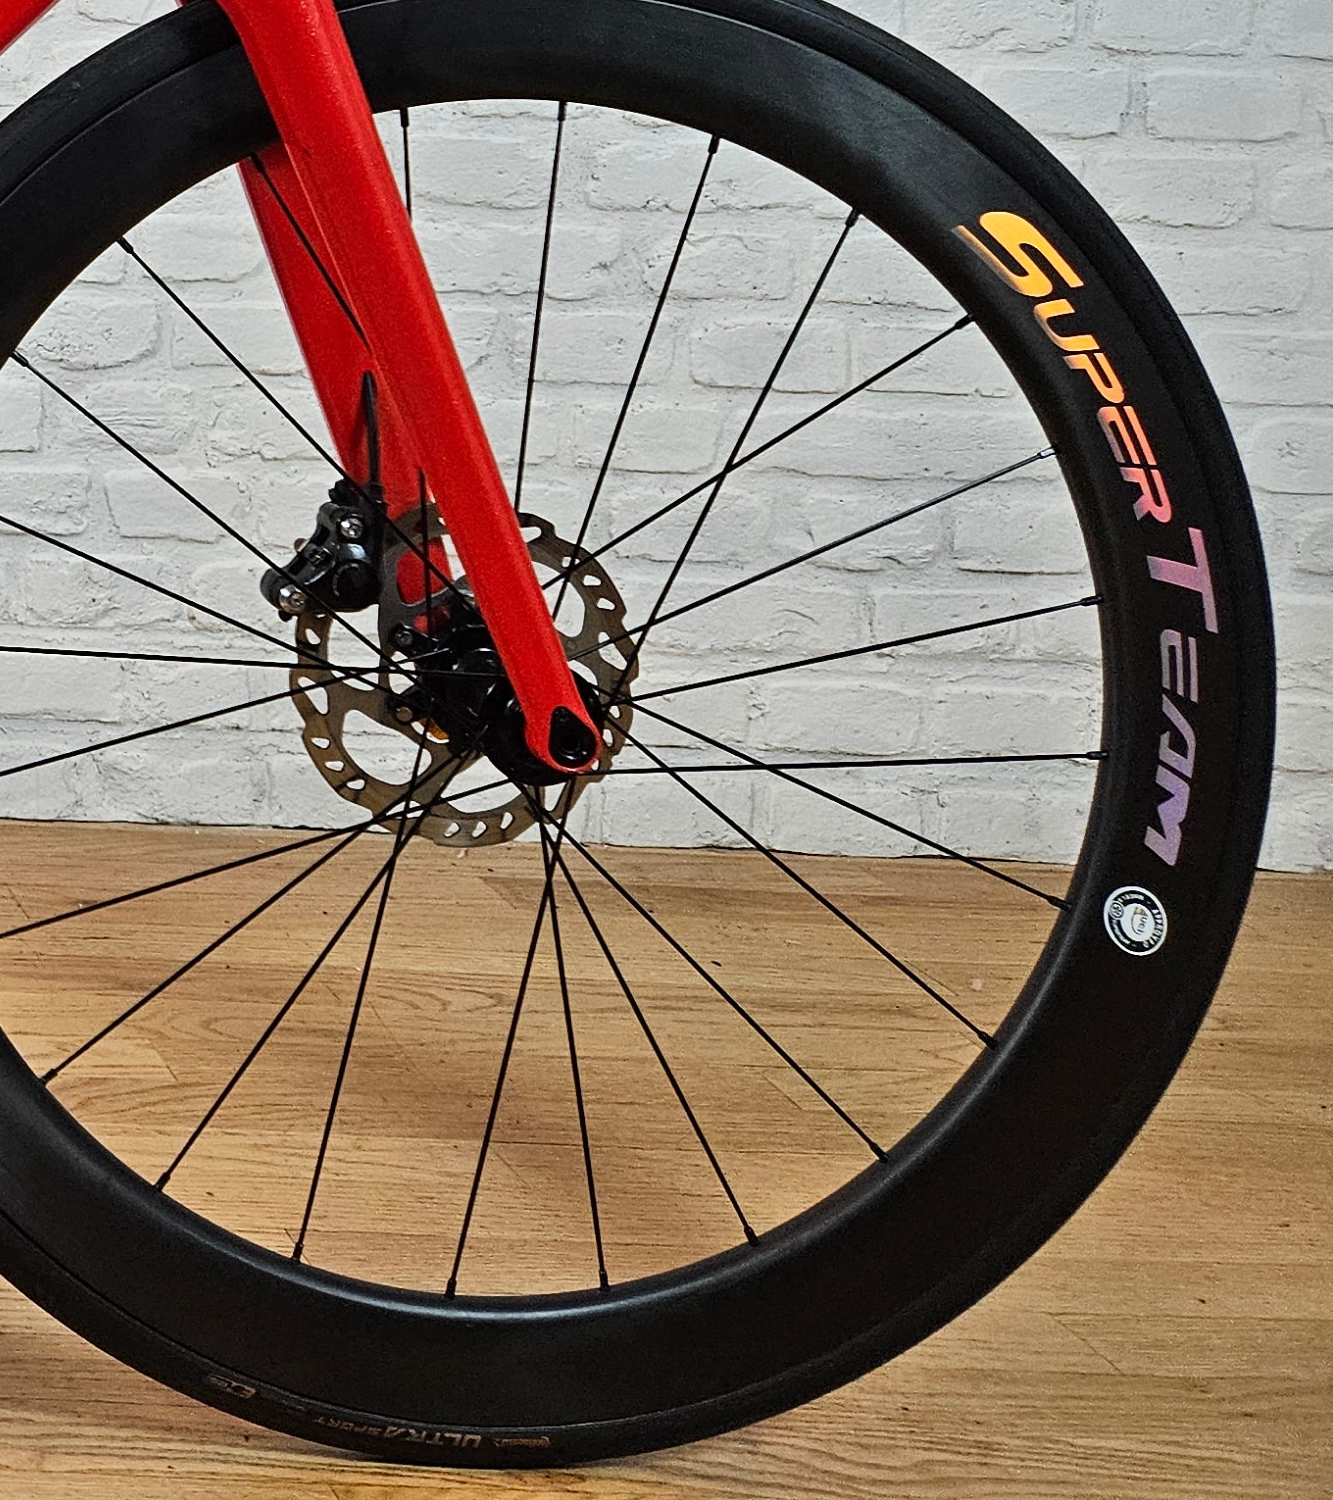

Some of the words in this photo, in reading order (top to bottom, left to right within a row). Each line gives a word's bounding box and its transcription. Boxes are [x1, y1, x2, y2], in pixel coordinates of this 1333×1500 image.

[952, 211, 1174, 524] SUPER
[1144, 527, 1220, 867] TEAM
[383, 1424, 483, 1449] ULTRA
